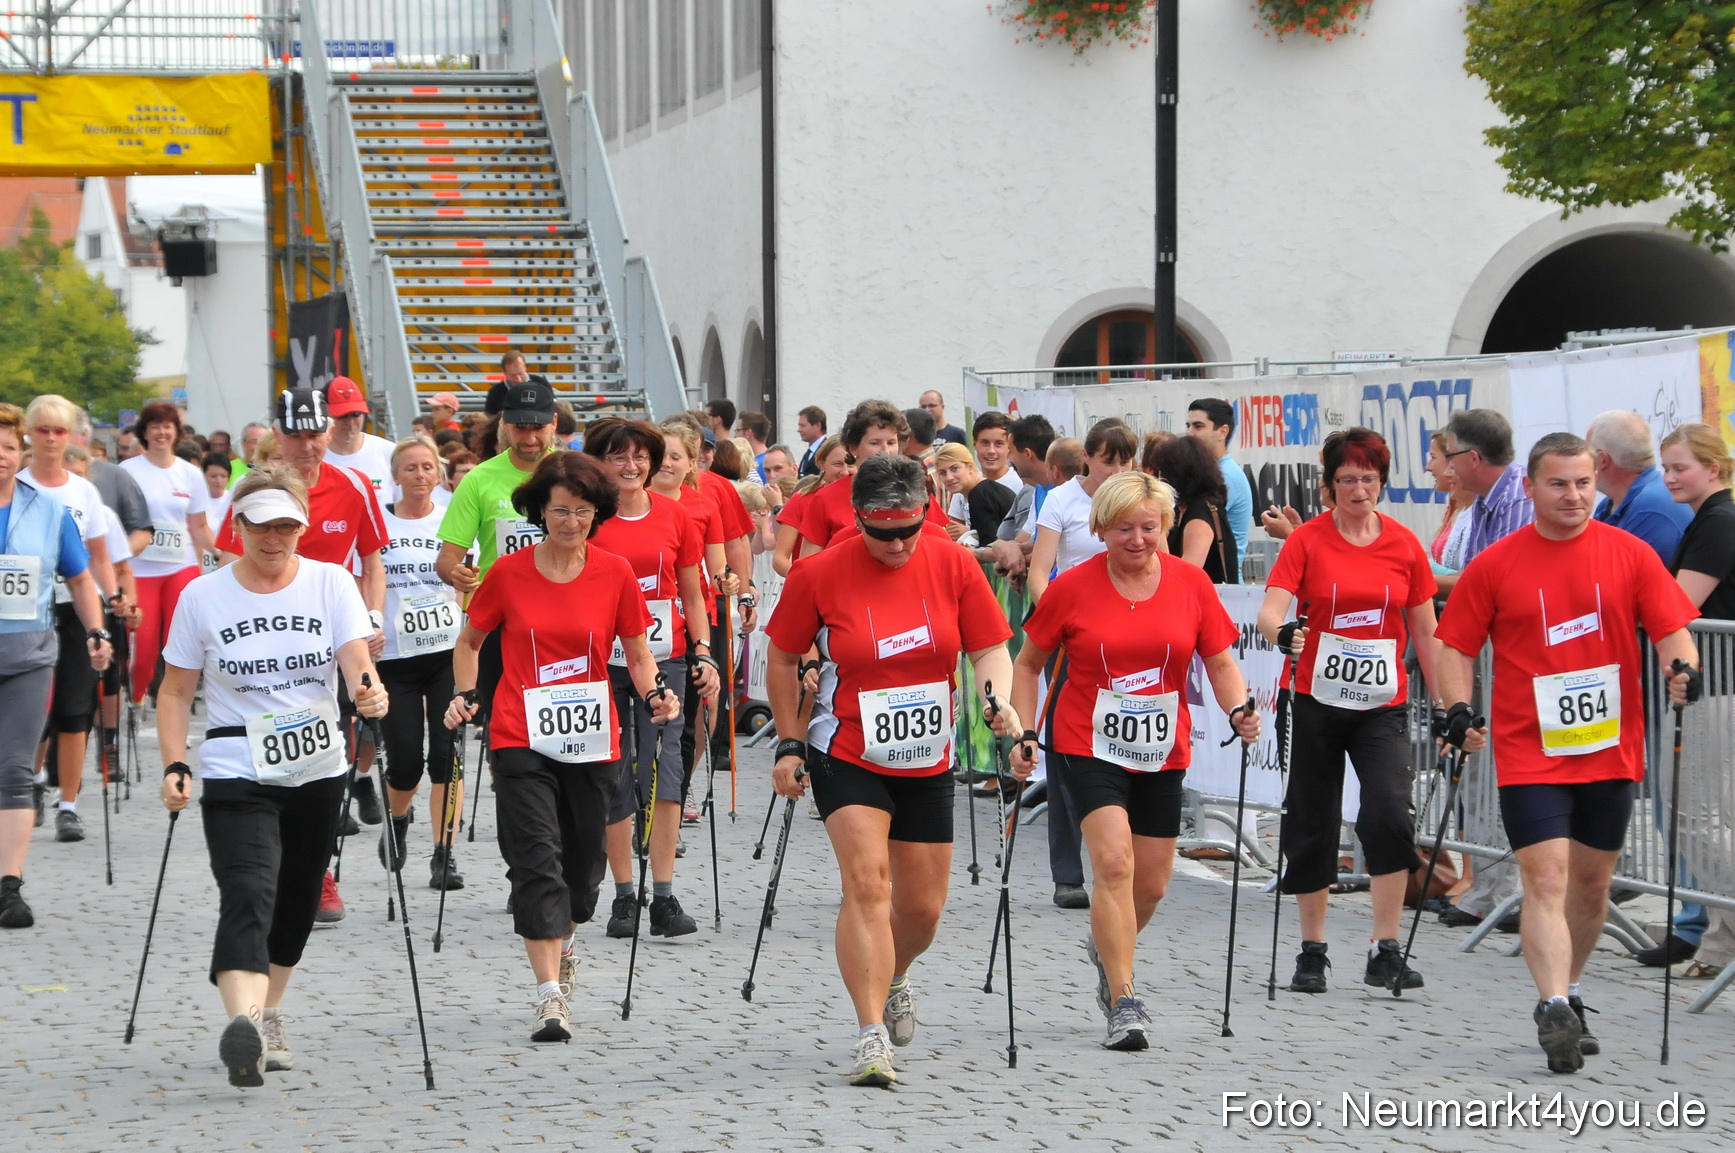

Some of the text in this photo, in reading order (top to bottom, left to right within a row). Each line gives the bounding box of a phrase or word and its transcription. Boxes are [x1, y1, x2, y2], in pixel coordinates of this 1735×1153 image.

[83, 123, 231, 136] Neumarkter Stadtlauf
[1240, 392, 1320, 448] INTERSPORT
[0, 573, 30, 596] 65
[403, 605, 454, 634] 8013
[1347, 615, 1369, 623] DEHN
[219, 615, 322, 645] BERGER
[1563, 622, 1585, 635] DEHN
[415, 633, 449, 648] Brigitte
[892, 636, 915, 649] DEHN
[1343, 643, 1375, 653] BOCK
[219, 647, 332, 675] POWER GIRLS
[552, 664, 575, 676] DEHN
[1324, 655, 1388, 686] 8020
[272, 680, 291, 692] and
[293, 676, 326, 688] talking
[1125, 676, 1147, 688] DEHN
[1564, 673, 1599, 687] BOCK
[551, 689, 588, 699] BOCK
[888, 690, 927, 704] BOCK
[1340, 687, 1369, 702] Rosa
[1121, 699, 1156, 710] BOCK
[1558, 689, 1609, 726] 864
[273, 708, 312, 726] BOCK
[538, 703, 602, 736] 8034
[875, 705, 943, 744] 8039
[1103, 712, 1169, 743] 8019
[262, 719, 331, 765] 8089
[888, 745, 932, 763] Brigitte
[1108, 743, 1164, 762] Rosmarie
